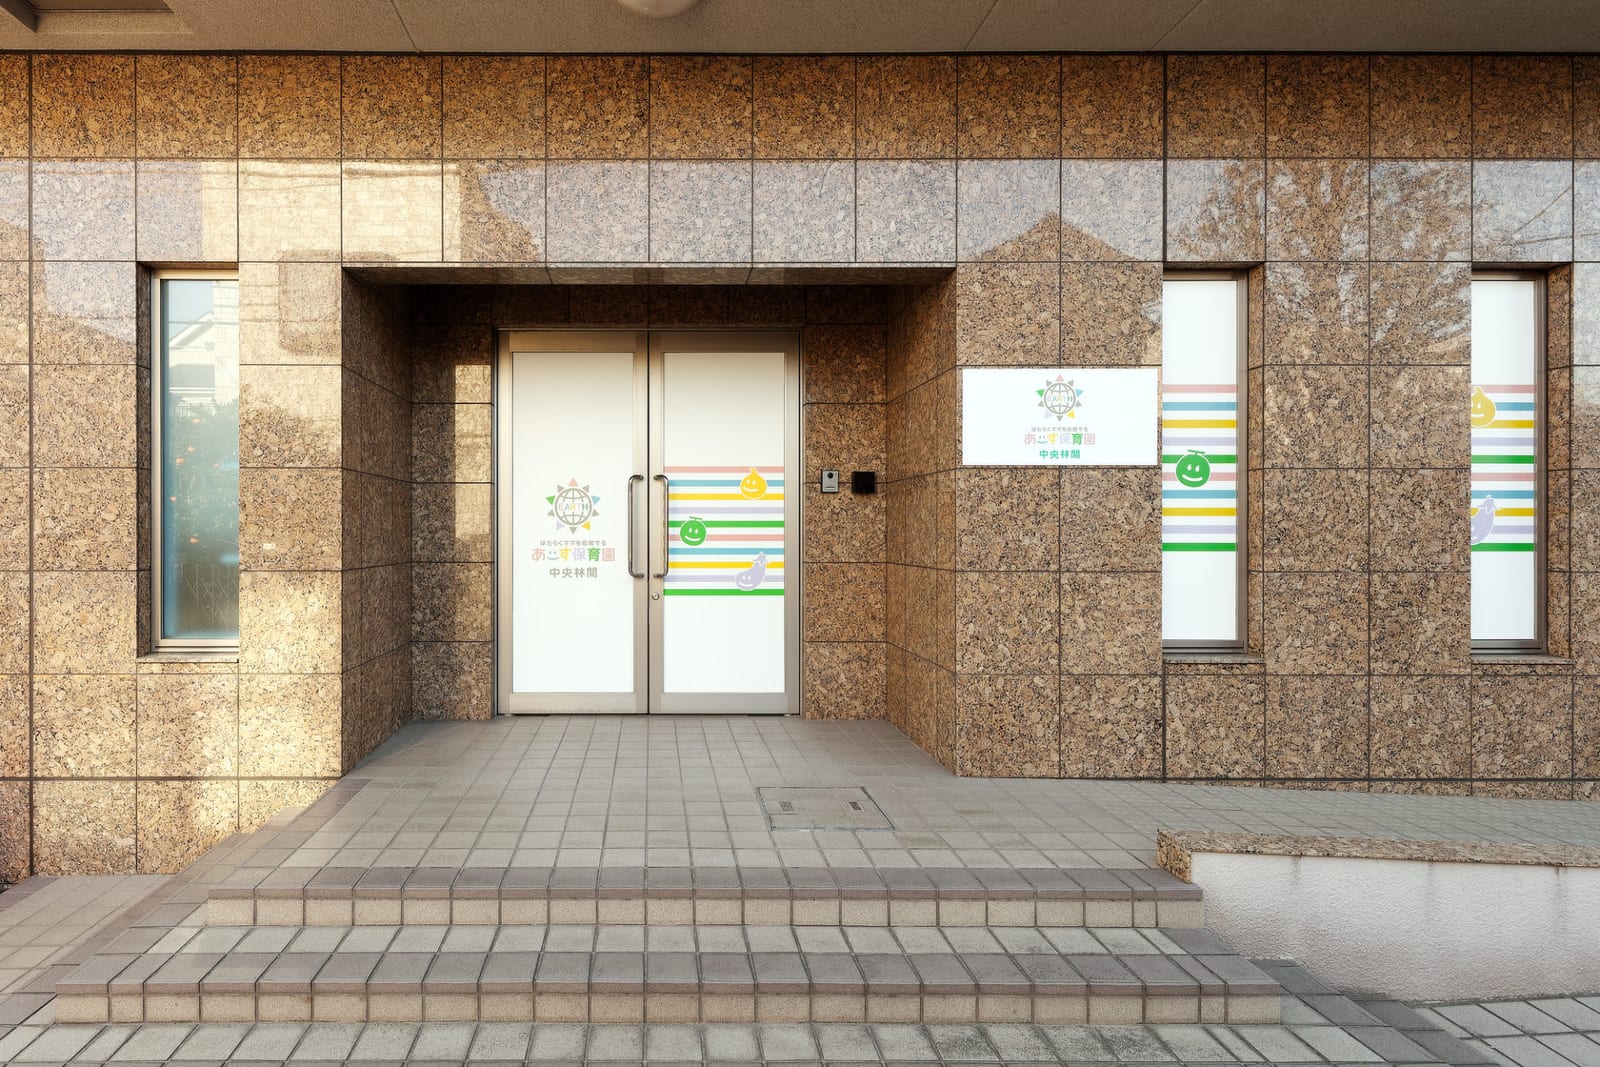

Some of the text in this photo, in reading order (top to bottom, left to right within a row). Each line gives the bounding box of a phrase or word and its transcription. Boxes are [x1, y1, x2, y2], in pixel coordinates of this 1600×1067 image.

[1039, 449, 1081, 459] 中央林間
[558, 502, 589, 511] EARTH
[549, 567, 598, 578] 中央林間
